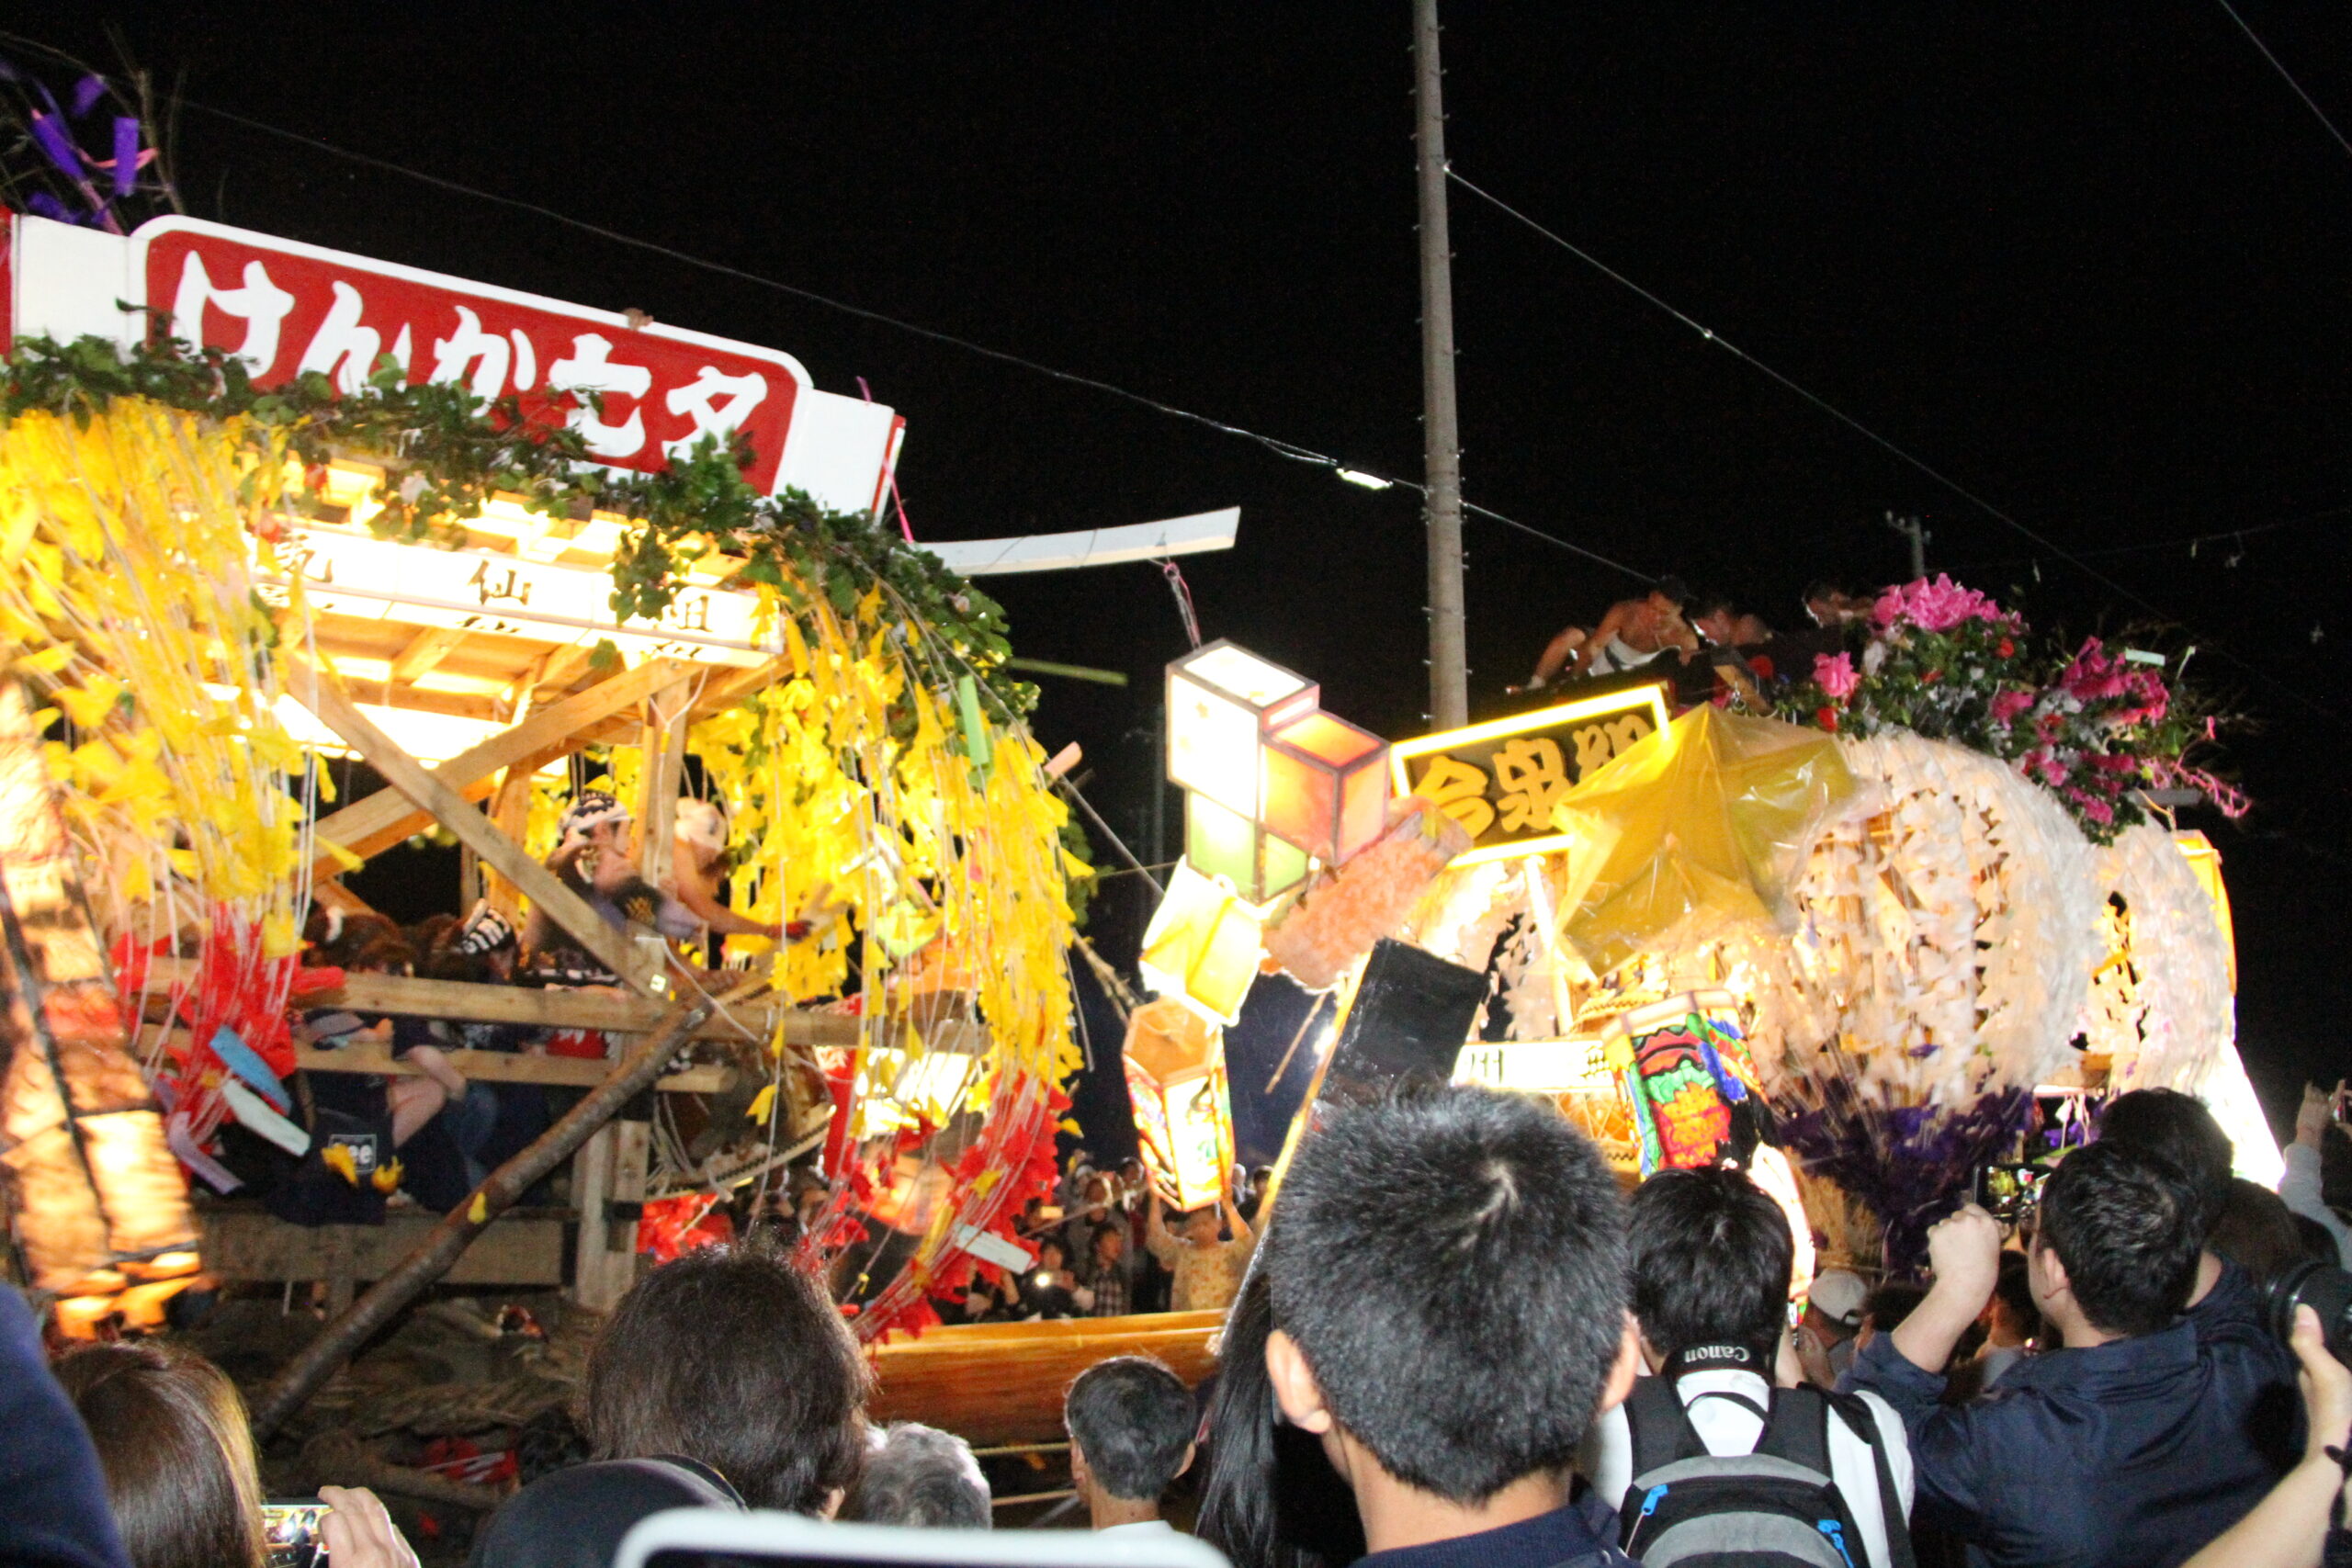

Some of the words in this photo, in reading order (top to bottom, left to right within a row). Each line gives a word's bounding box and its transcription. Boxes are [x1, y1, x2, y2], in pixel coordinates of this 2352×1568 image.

[173, 248, 767, 462] けんか七夕
[1684, 1345, 1751, 1363] Canon
